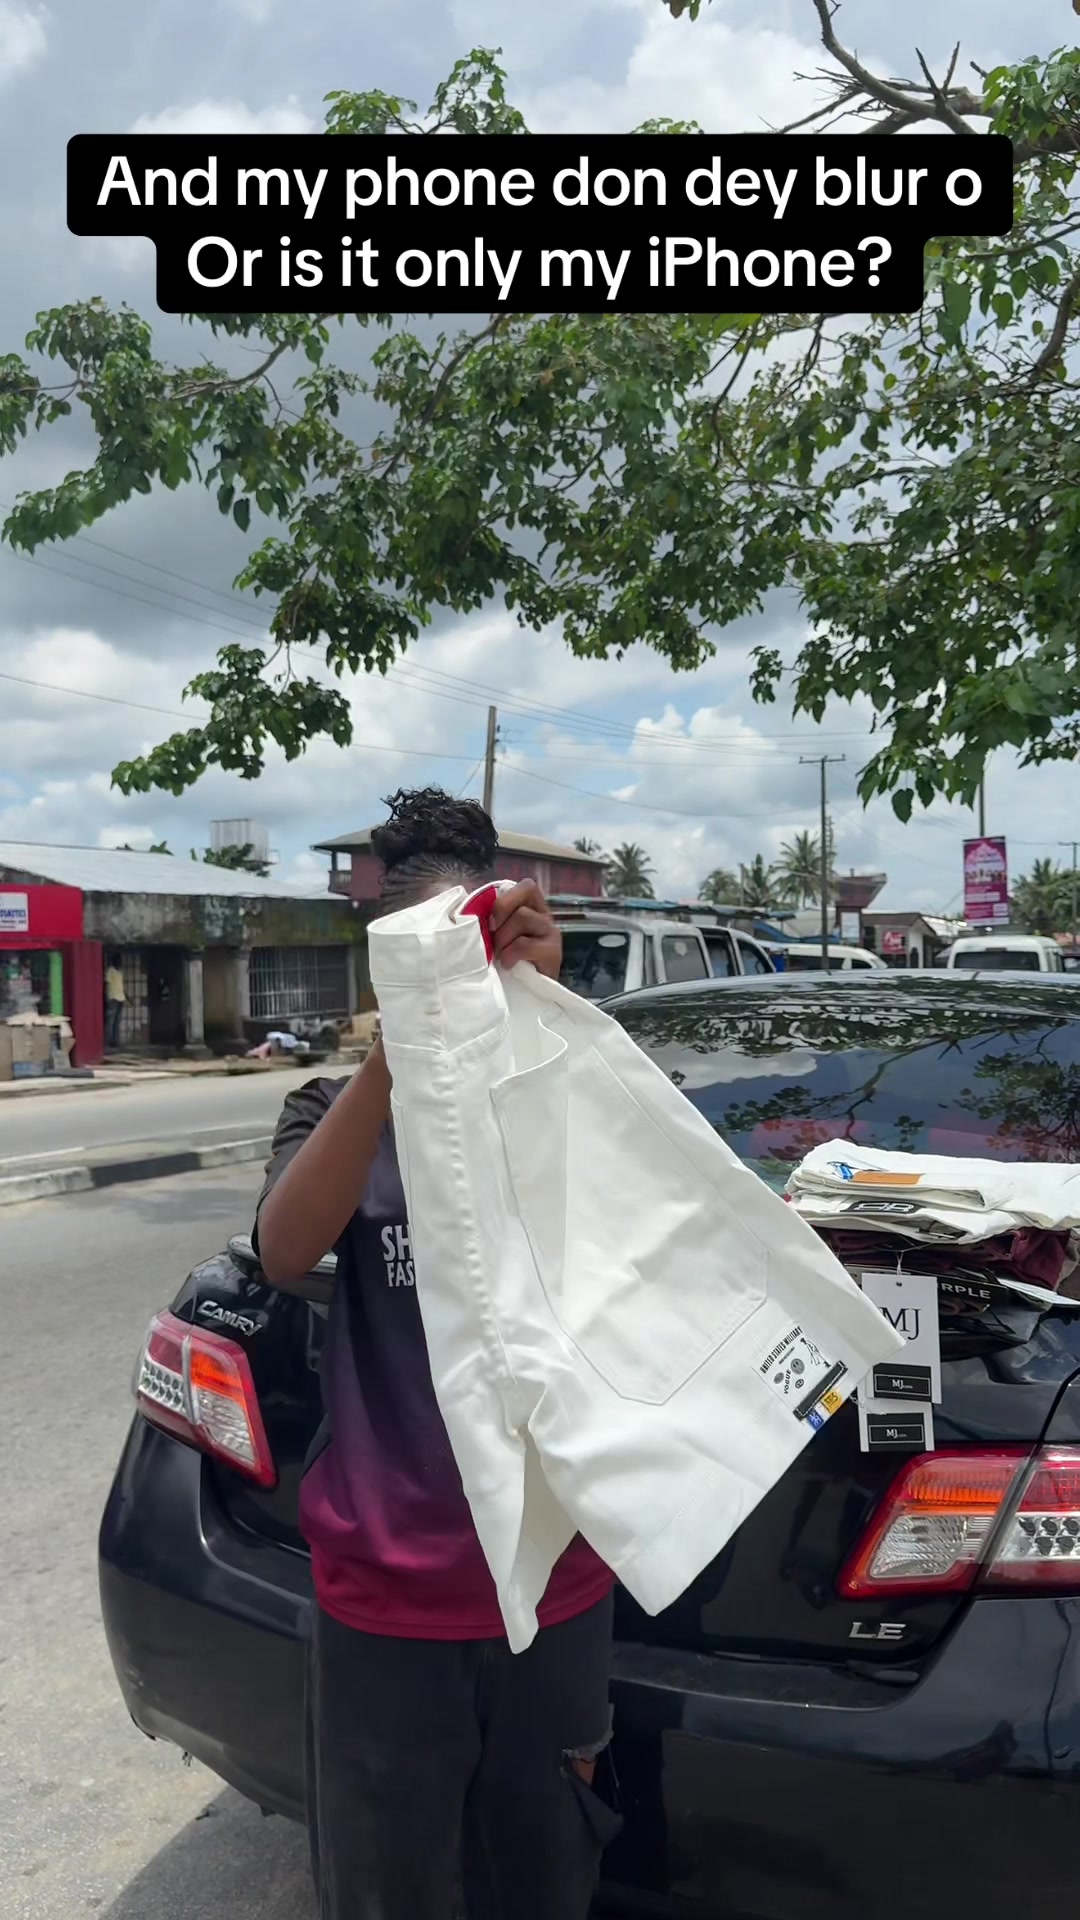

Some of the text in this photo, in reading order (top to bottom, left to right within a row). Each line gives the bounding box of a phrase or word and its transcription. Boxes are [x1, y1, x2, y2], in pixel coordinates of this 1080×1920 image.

[197, 1300, 262, 1336] CAMRY
[879, 1307, 921, 1340] MJ
[760, 1354, 775, 1374] UNITED
[771, 1341, 787, 1359] STATES
[783, 1326, 803, 1346] MILITARY
[892, 1379, 904, 1391] MJ
[886, 1429, 898, 1439] MJ
[849, 1622, 906, 1640] LE
